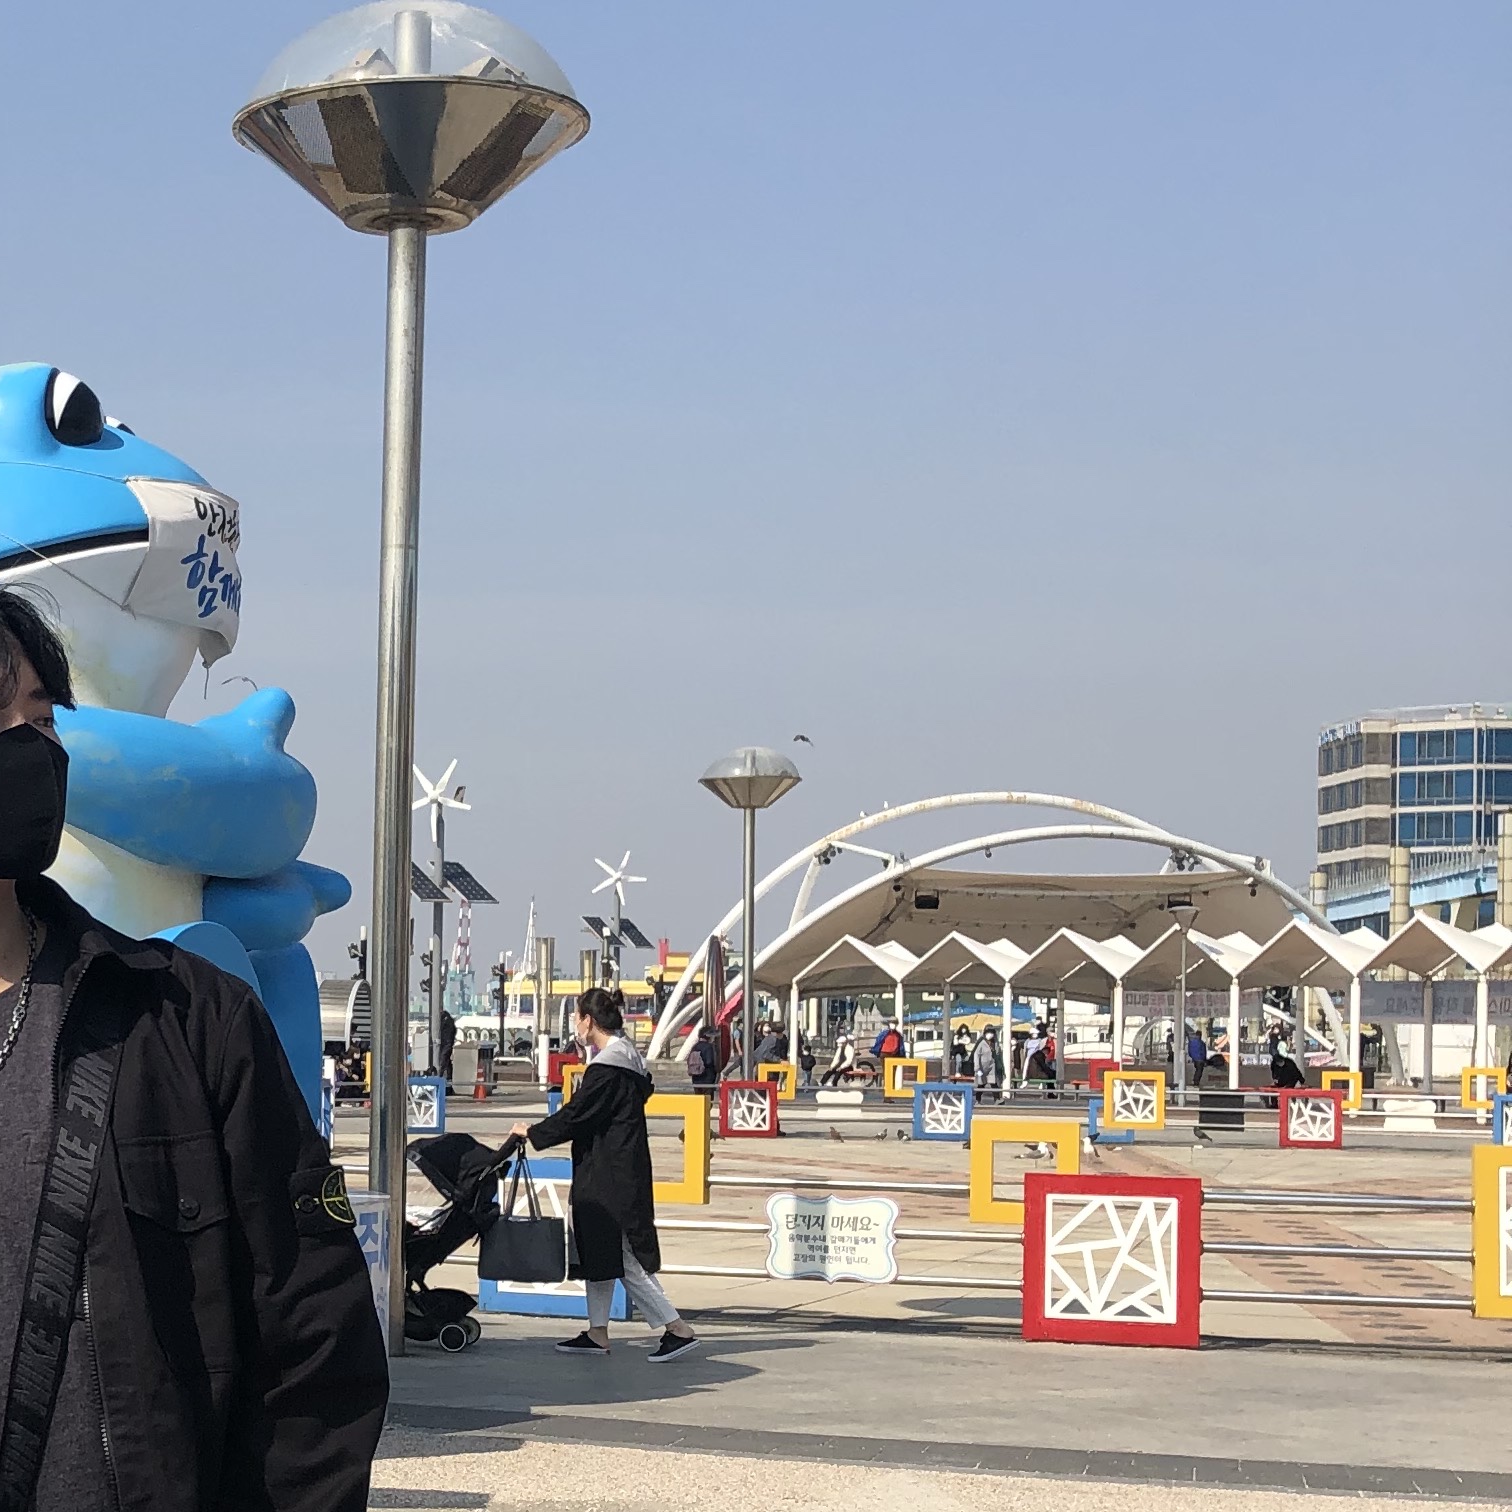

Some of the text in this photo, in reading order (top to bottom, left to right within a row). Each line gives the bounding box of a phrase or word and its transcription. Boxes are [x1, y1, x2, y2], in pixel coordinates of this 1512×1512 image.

[45, 1126, 98, 1222] NIKE
[785, 1213, 826, 1231] 던지지
[28, 1221, 81, 1320] NIKE
[10, 1320, 63, 1419] NIKE
